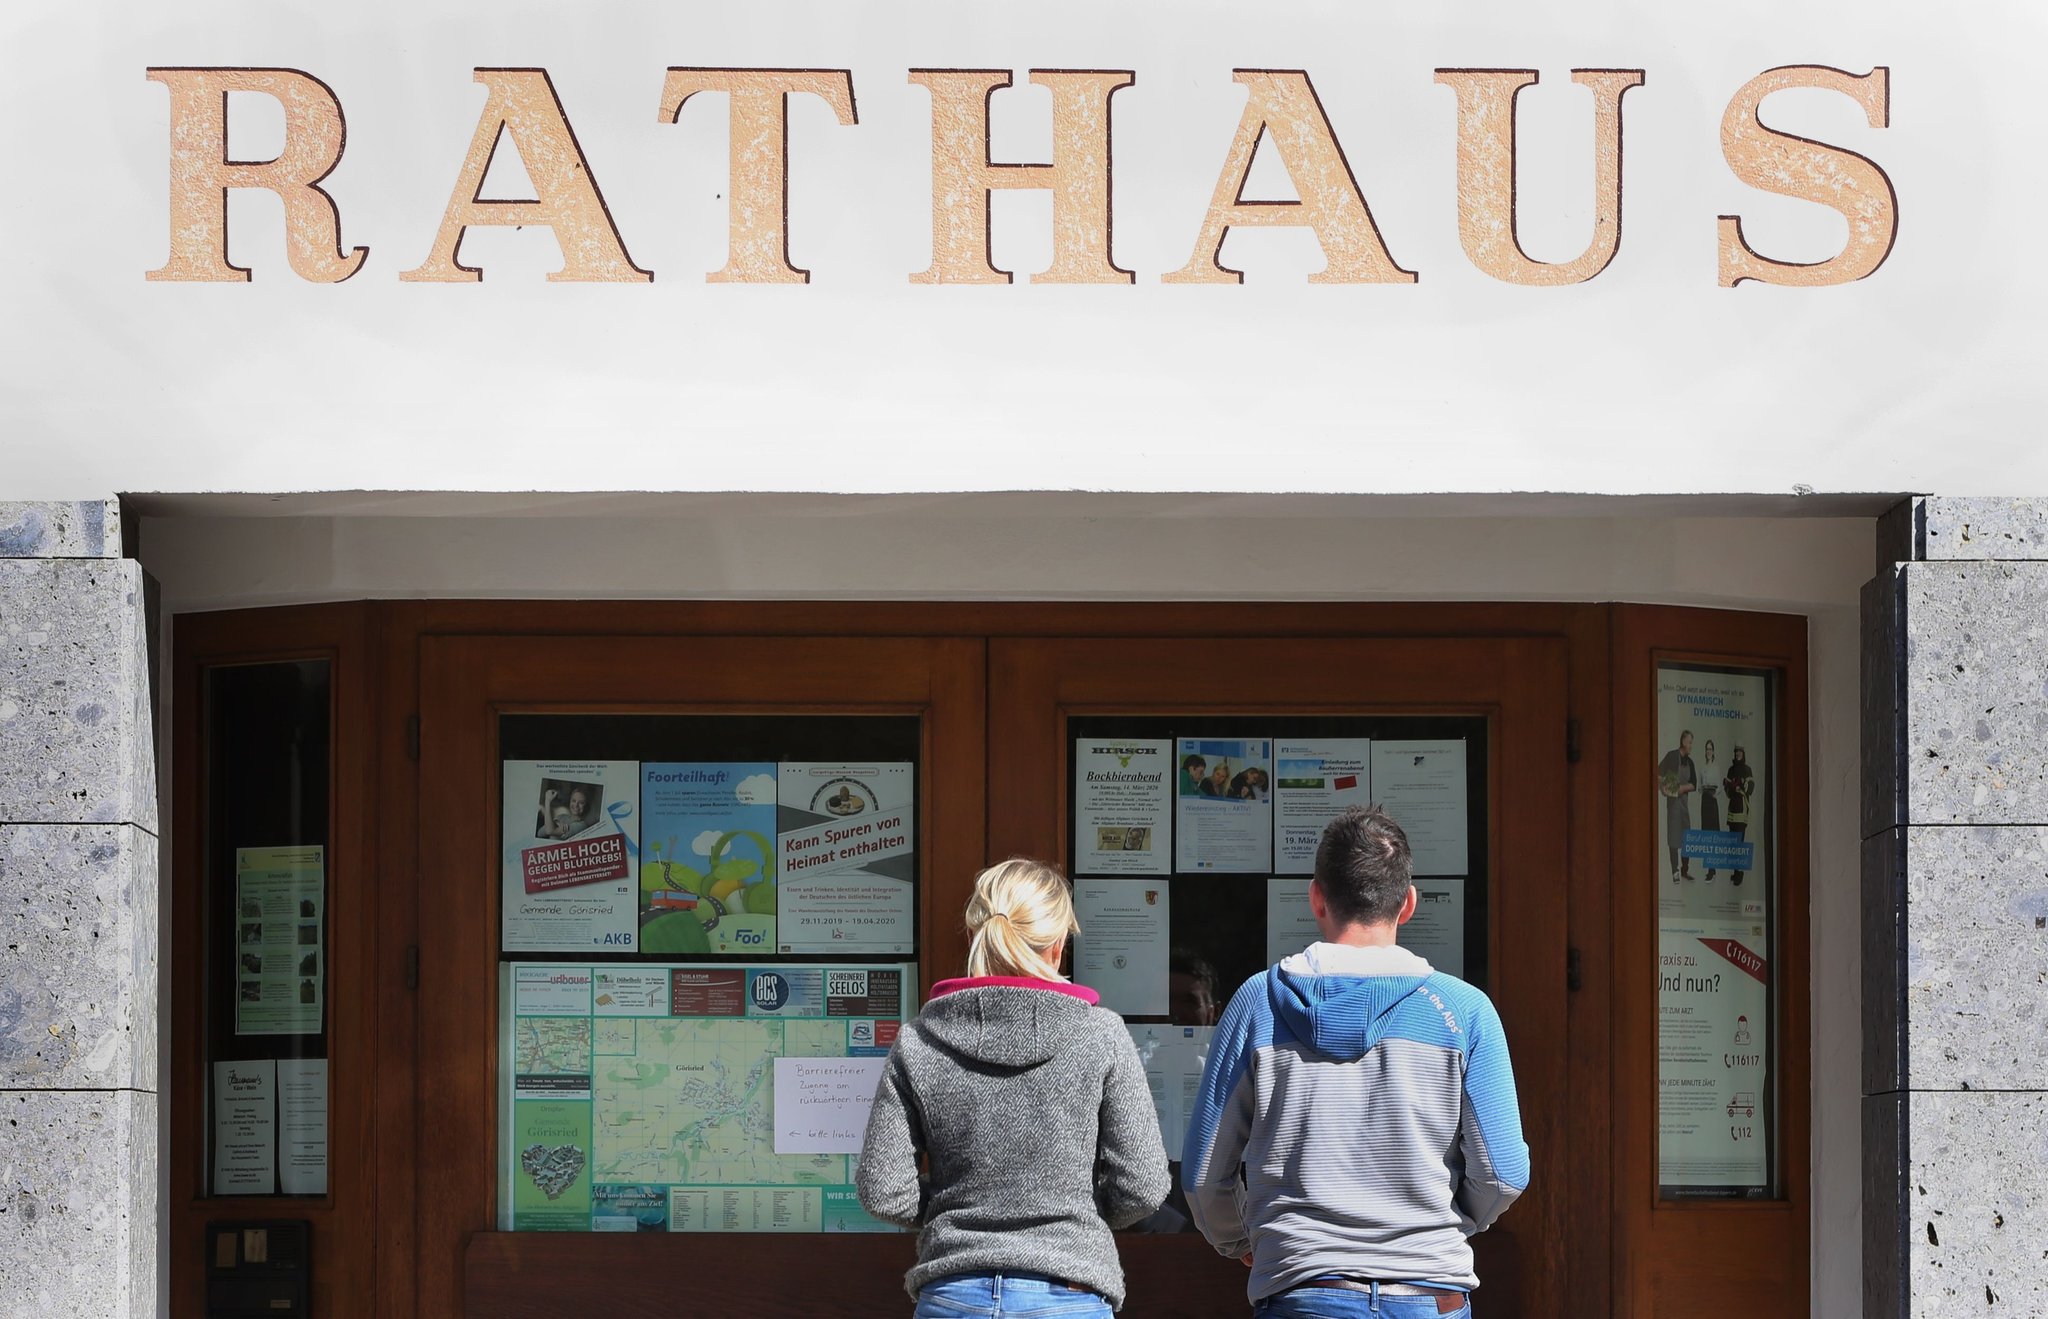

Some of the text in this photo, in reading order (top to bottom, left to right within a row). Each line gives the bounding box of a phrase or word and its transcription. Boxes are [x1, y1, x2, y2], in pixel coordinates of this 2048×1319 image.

[145, 64, 1898, 289] RATHAUS
[1677, 694, 1724, 706] DYNAMISCH
[1693, 707, 1740, 719] DYNAMISCH
[1091, 747, 1158, 755] HIRSCH
[647, 770, 730, 786] Foorteilhaft!
[1086, 771, 1162, 783] Bockbierabend
[785, 816, 901, 853] Kann Spuren von
[527, 839, 620, 866] ÄRMEL HOCH
[786, 850, 836, 872] Heimat
[839, 835, 905, 859] enthalten
[1685, 844, 1750, 856] DOPPELT ENGAGIERT
[528, 852, 622, 876] GEGEN BLUTKREBS!
[603, 932, 632, 945] AKB
[735, 928, 767, 944] Foo!
[1660, 953, 1698, 966] raxis zu.
[1732, 946, 1762, 972] 116117
[829, 972, 865, 981] SCHREINEREI
[829, 981, 865, 996] SEELOS
[1686, 974, 1721, 993] nun?
[1428, 994, 1445, 1011] the
[1731, 1055, 1760, 1066] 116117
[676, 1064, 705, 1072] Görisried
[795, 1063, 865, 1078] Barrierefreier
[799, 1080, 829, 1094] Zugang
[1667, 1079, 1680, 1088] JEDE
[527, 1127, 578, 1138] Görisried
[832, 1129, 856, 1139] links
[1738, 1126, 1752, 1138] 112
[826, 1192, 844, 1200] WIR
